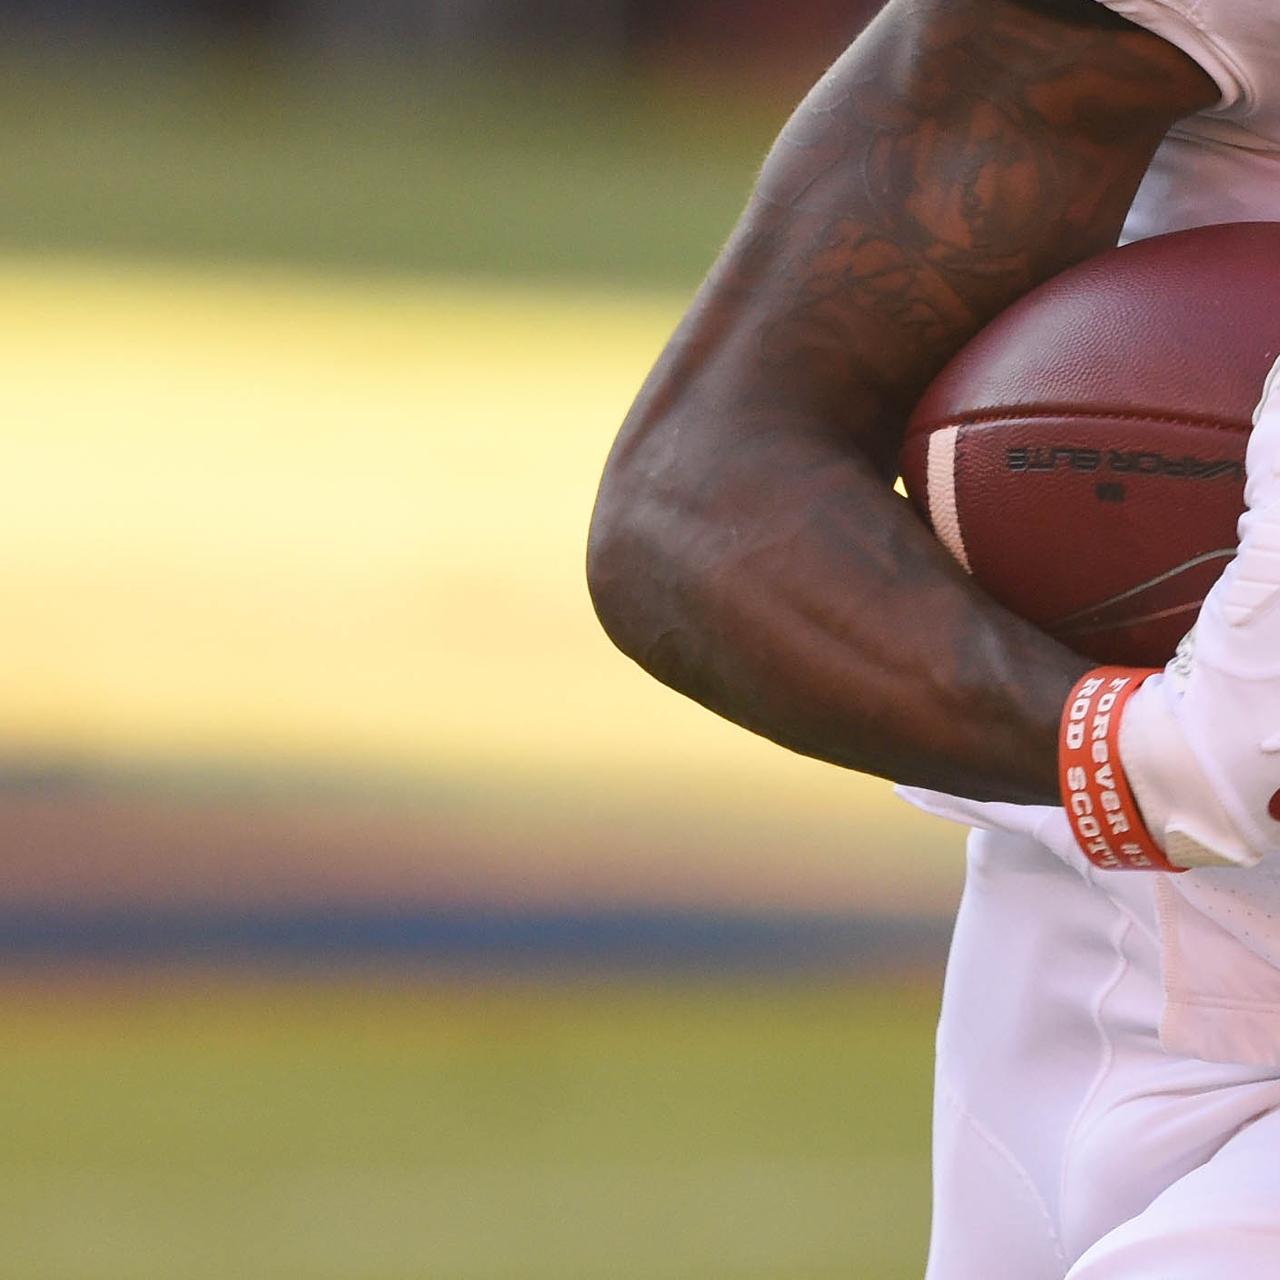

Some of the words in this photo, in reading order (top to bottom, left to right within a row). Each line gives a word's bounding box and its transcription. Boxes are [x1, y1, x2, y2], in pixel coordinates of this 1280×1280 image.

[1008, 447, 1099, 473] ELITE
[1066, 677, 1106, 751] ROD
[1091, 677, 1131, 836] FOREVER
